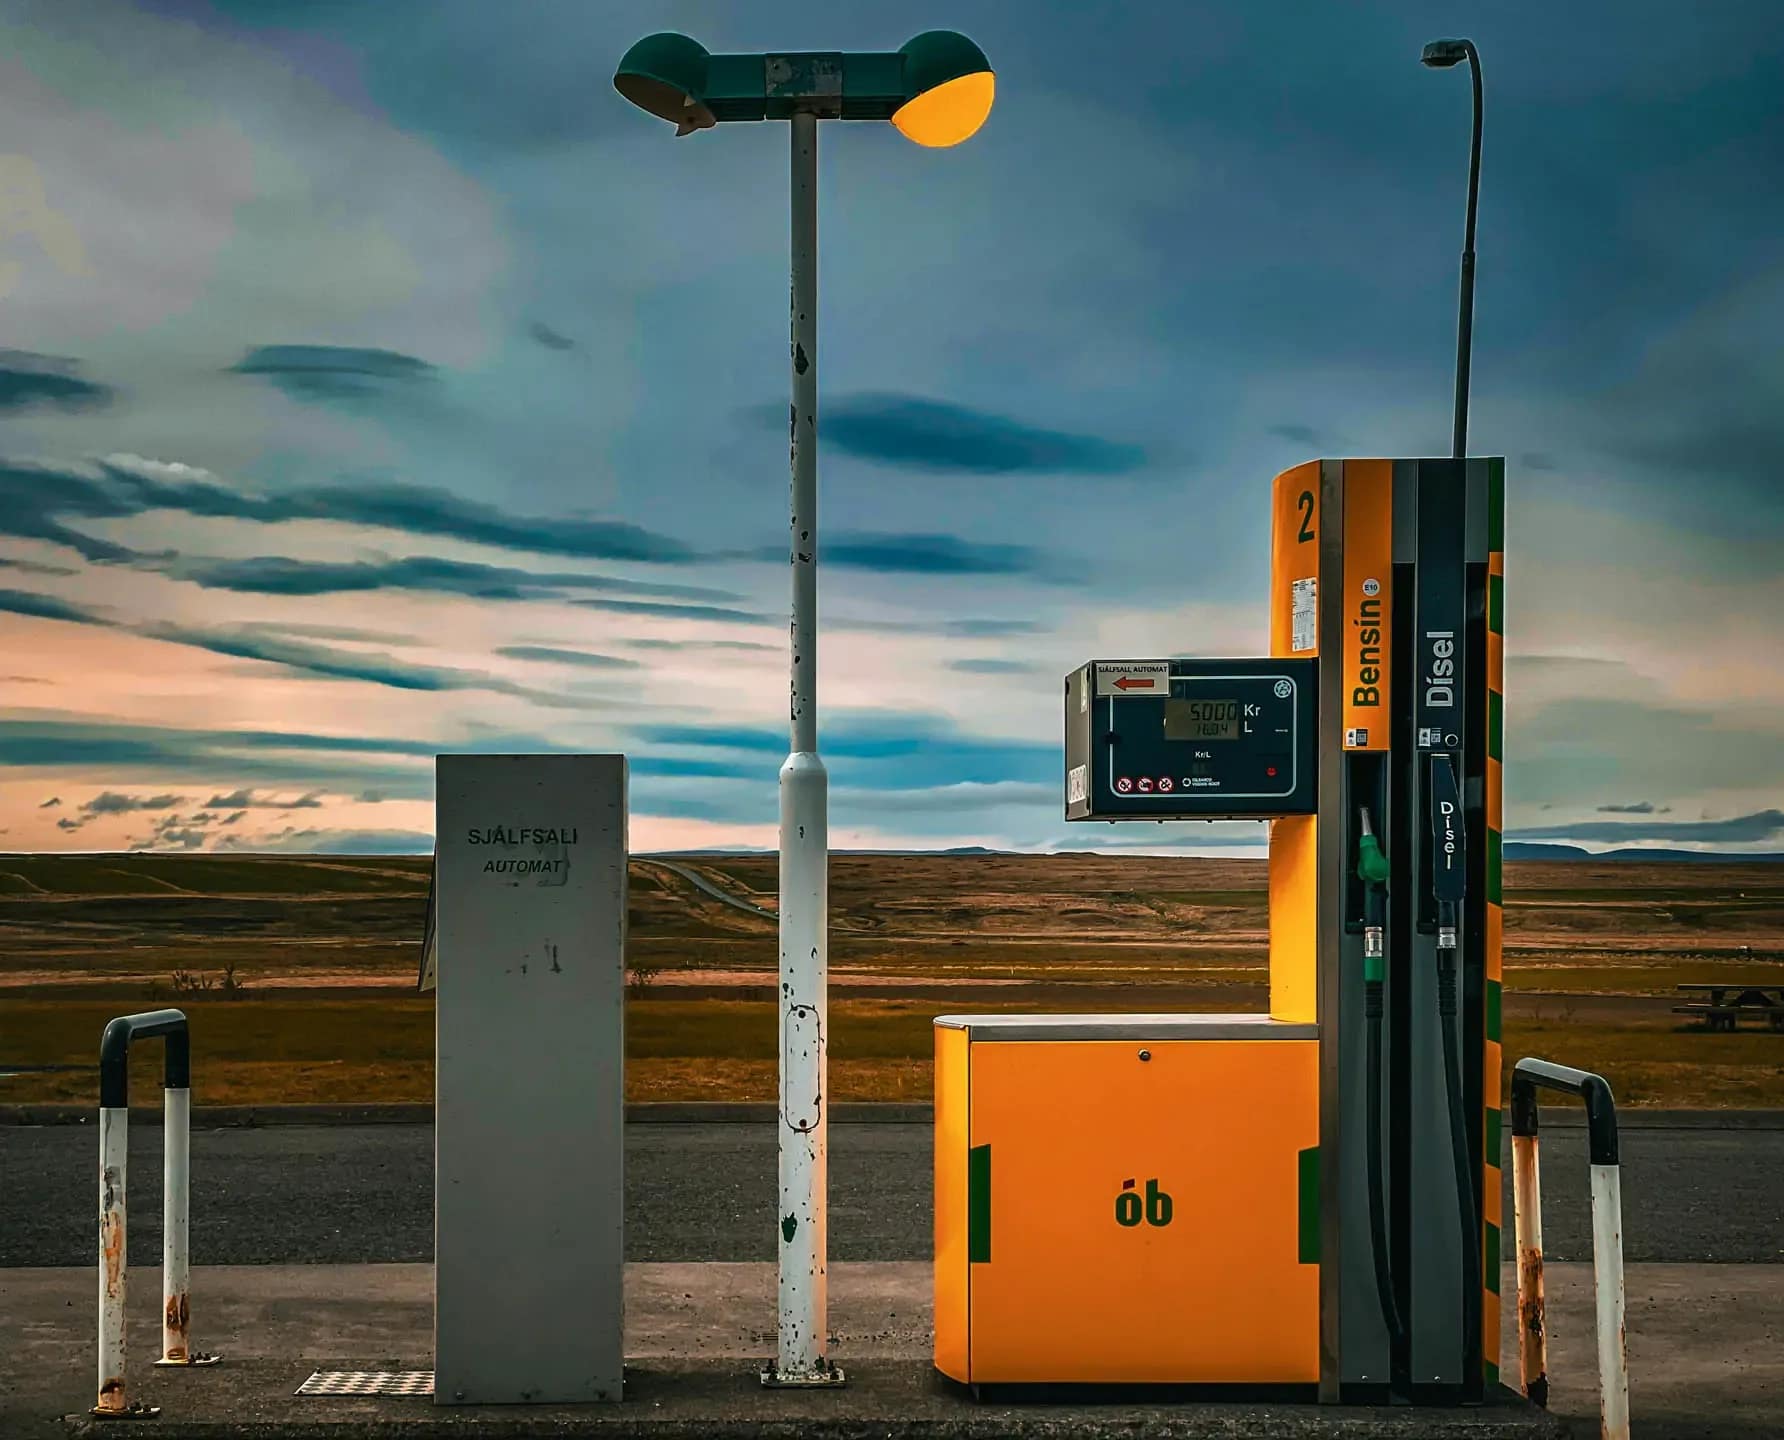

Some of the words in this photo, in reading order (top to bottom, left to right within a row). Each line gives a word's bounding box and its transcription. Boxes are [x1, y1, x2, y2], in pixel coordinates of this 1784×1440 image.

[1298, 490, 1315, 545] 2
[1352, 599, 1381, 707] Bensín
[1425, 631, 1455, 707] Dísel
[1191, 703, 1237, 721] 5000
[1244, 704, 1262, 717] Kr
[1244, 721, 1253, 733] L
[1195, 751, 1211, 759] Kr/L
[468, 825, 578, 845] SJÁLFSALI
[483, 860, 563, 873] AUTOMAT
[1115, 1178, 1173, 1227] ób
